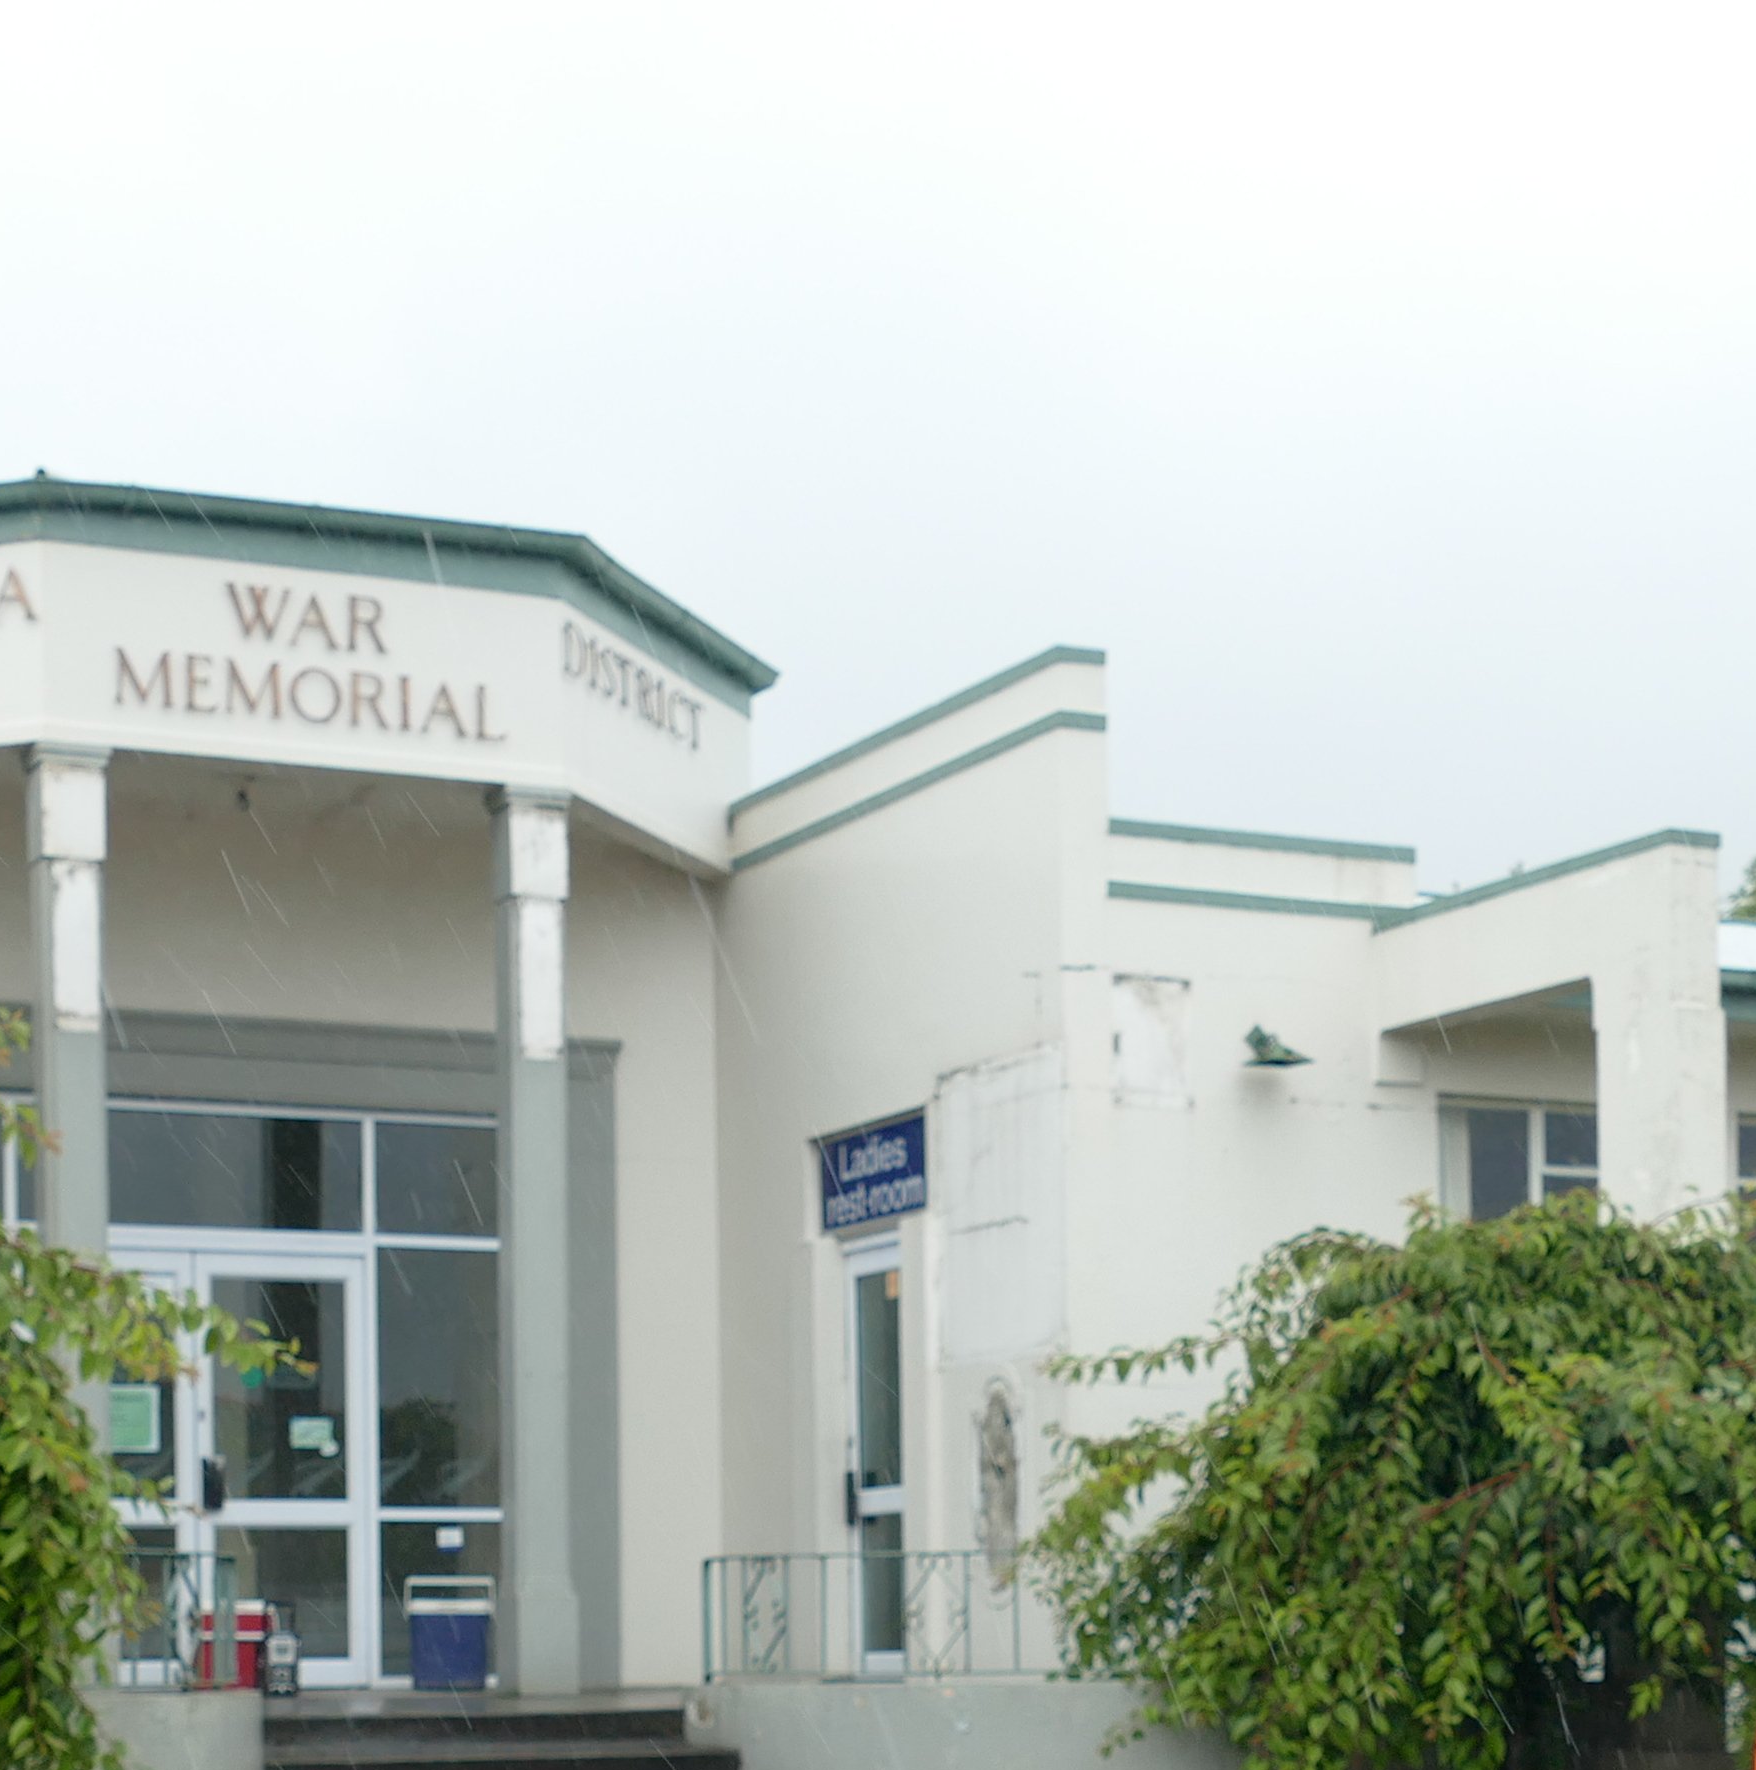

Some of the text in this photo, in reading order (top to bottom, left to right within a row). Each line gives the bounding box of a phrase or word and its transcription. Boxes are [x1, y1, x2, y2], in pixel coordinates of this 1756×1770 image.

[226, 581, 387, 654] WAR
[114, 646, 507, 742] MEMORIAL
[563, 621, 703, 751] DISTRICT
[838, 1135, 908, 1182] Ladies
[826, 1175, 924, 1223] rest room
